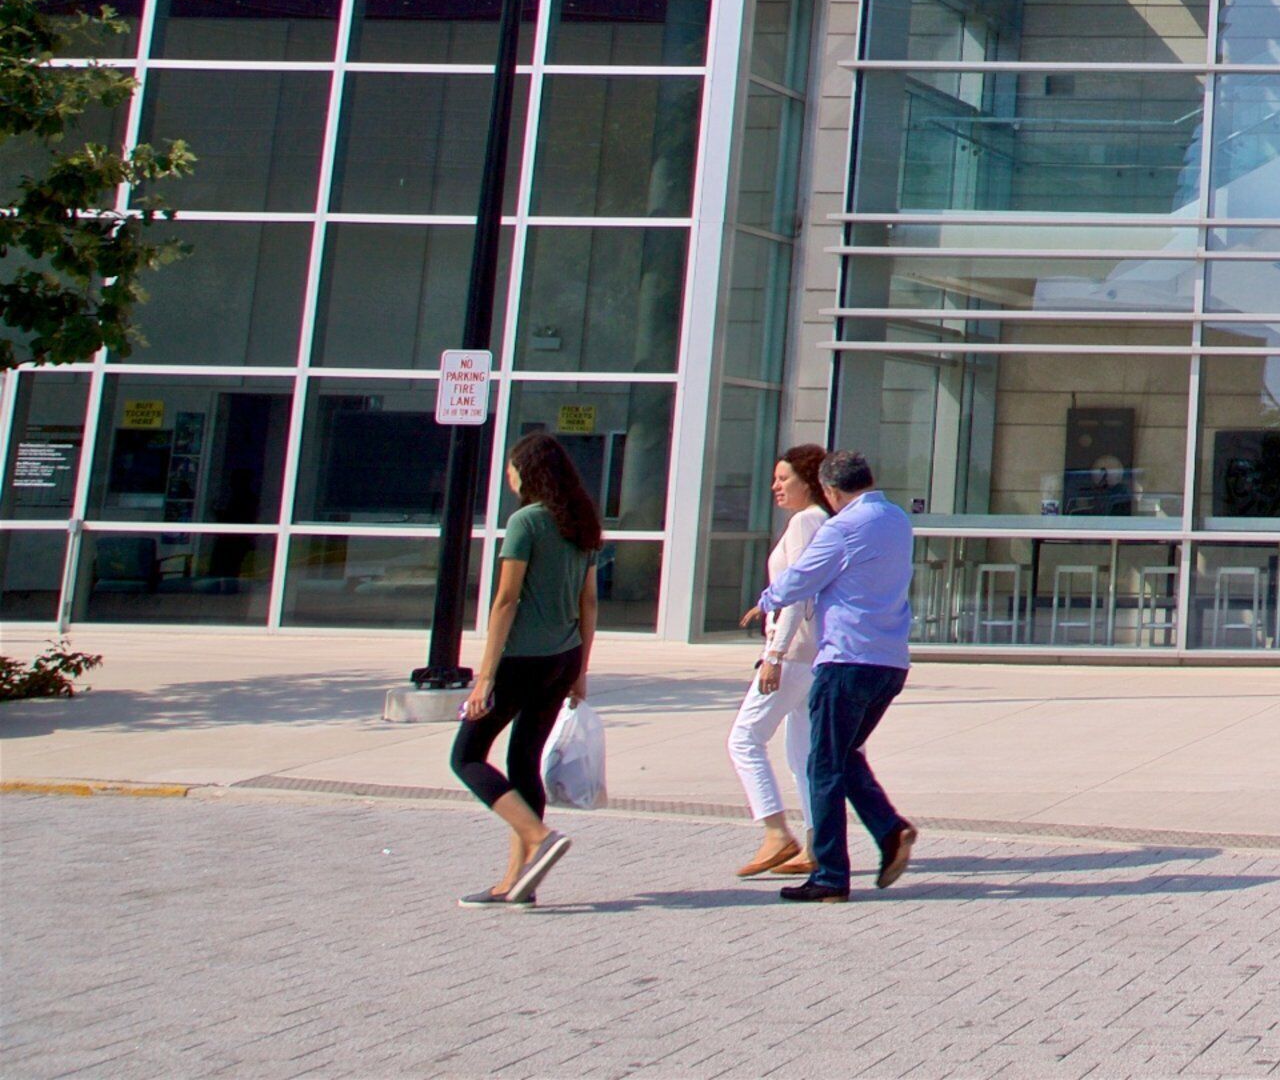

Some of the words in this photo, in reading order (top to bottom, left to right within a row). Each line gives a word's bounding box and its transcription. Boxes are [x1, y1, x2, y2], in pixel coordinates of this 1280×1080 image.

[461, 359, 473, 369] NO
[446, 372, 485, 382] PARKING
[454, 383, 475, 394] FIRE
[449, 397, 475, 406] LANE
